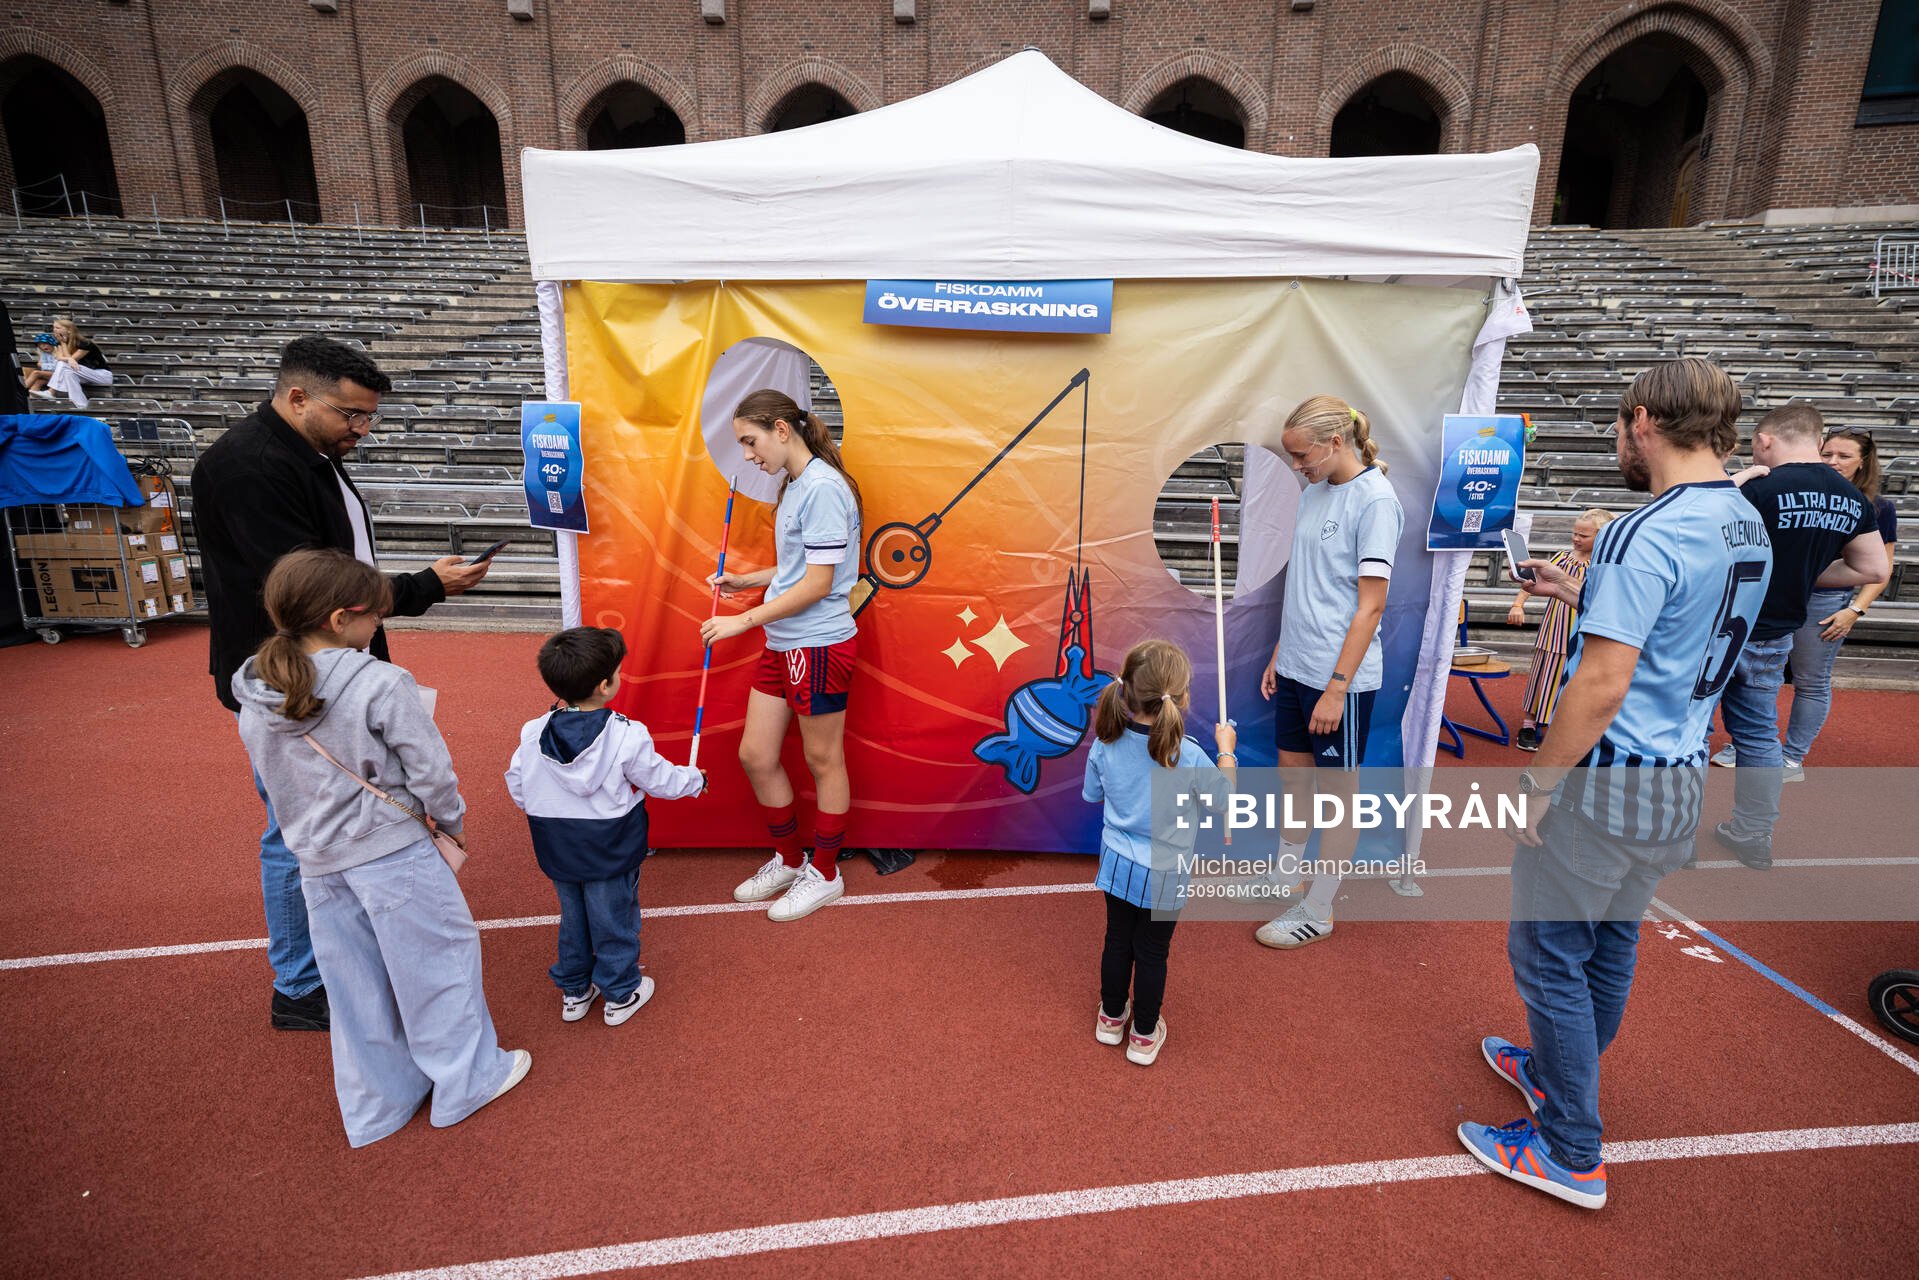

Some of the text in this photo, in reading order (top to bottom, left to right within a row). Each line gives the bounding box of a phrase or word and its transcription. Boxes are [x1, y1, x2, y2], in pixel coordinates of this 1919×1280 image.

[935, 282, 1043, 298] FISKDAMM
[877, 292, 1099, 318] ÖVERRASKNING
[532, 434, 569, 450] FISKDAMM
[1458, 449, 1510, 465] FISKDAMM
[1777, 491, 1827, 510] ULTRA
[37, 562, 59, 612] LEGION
[1688, 560, 1767, 706] 5
